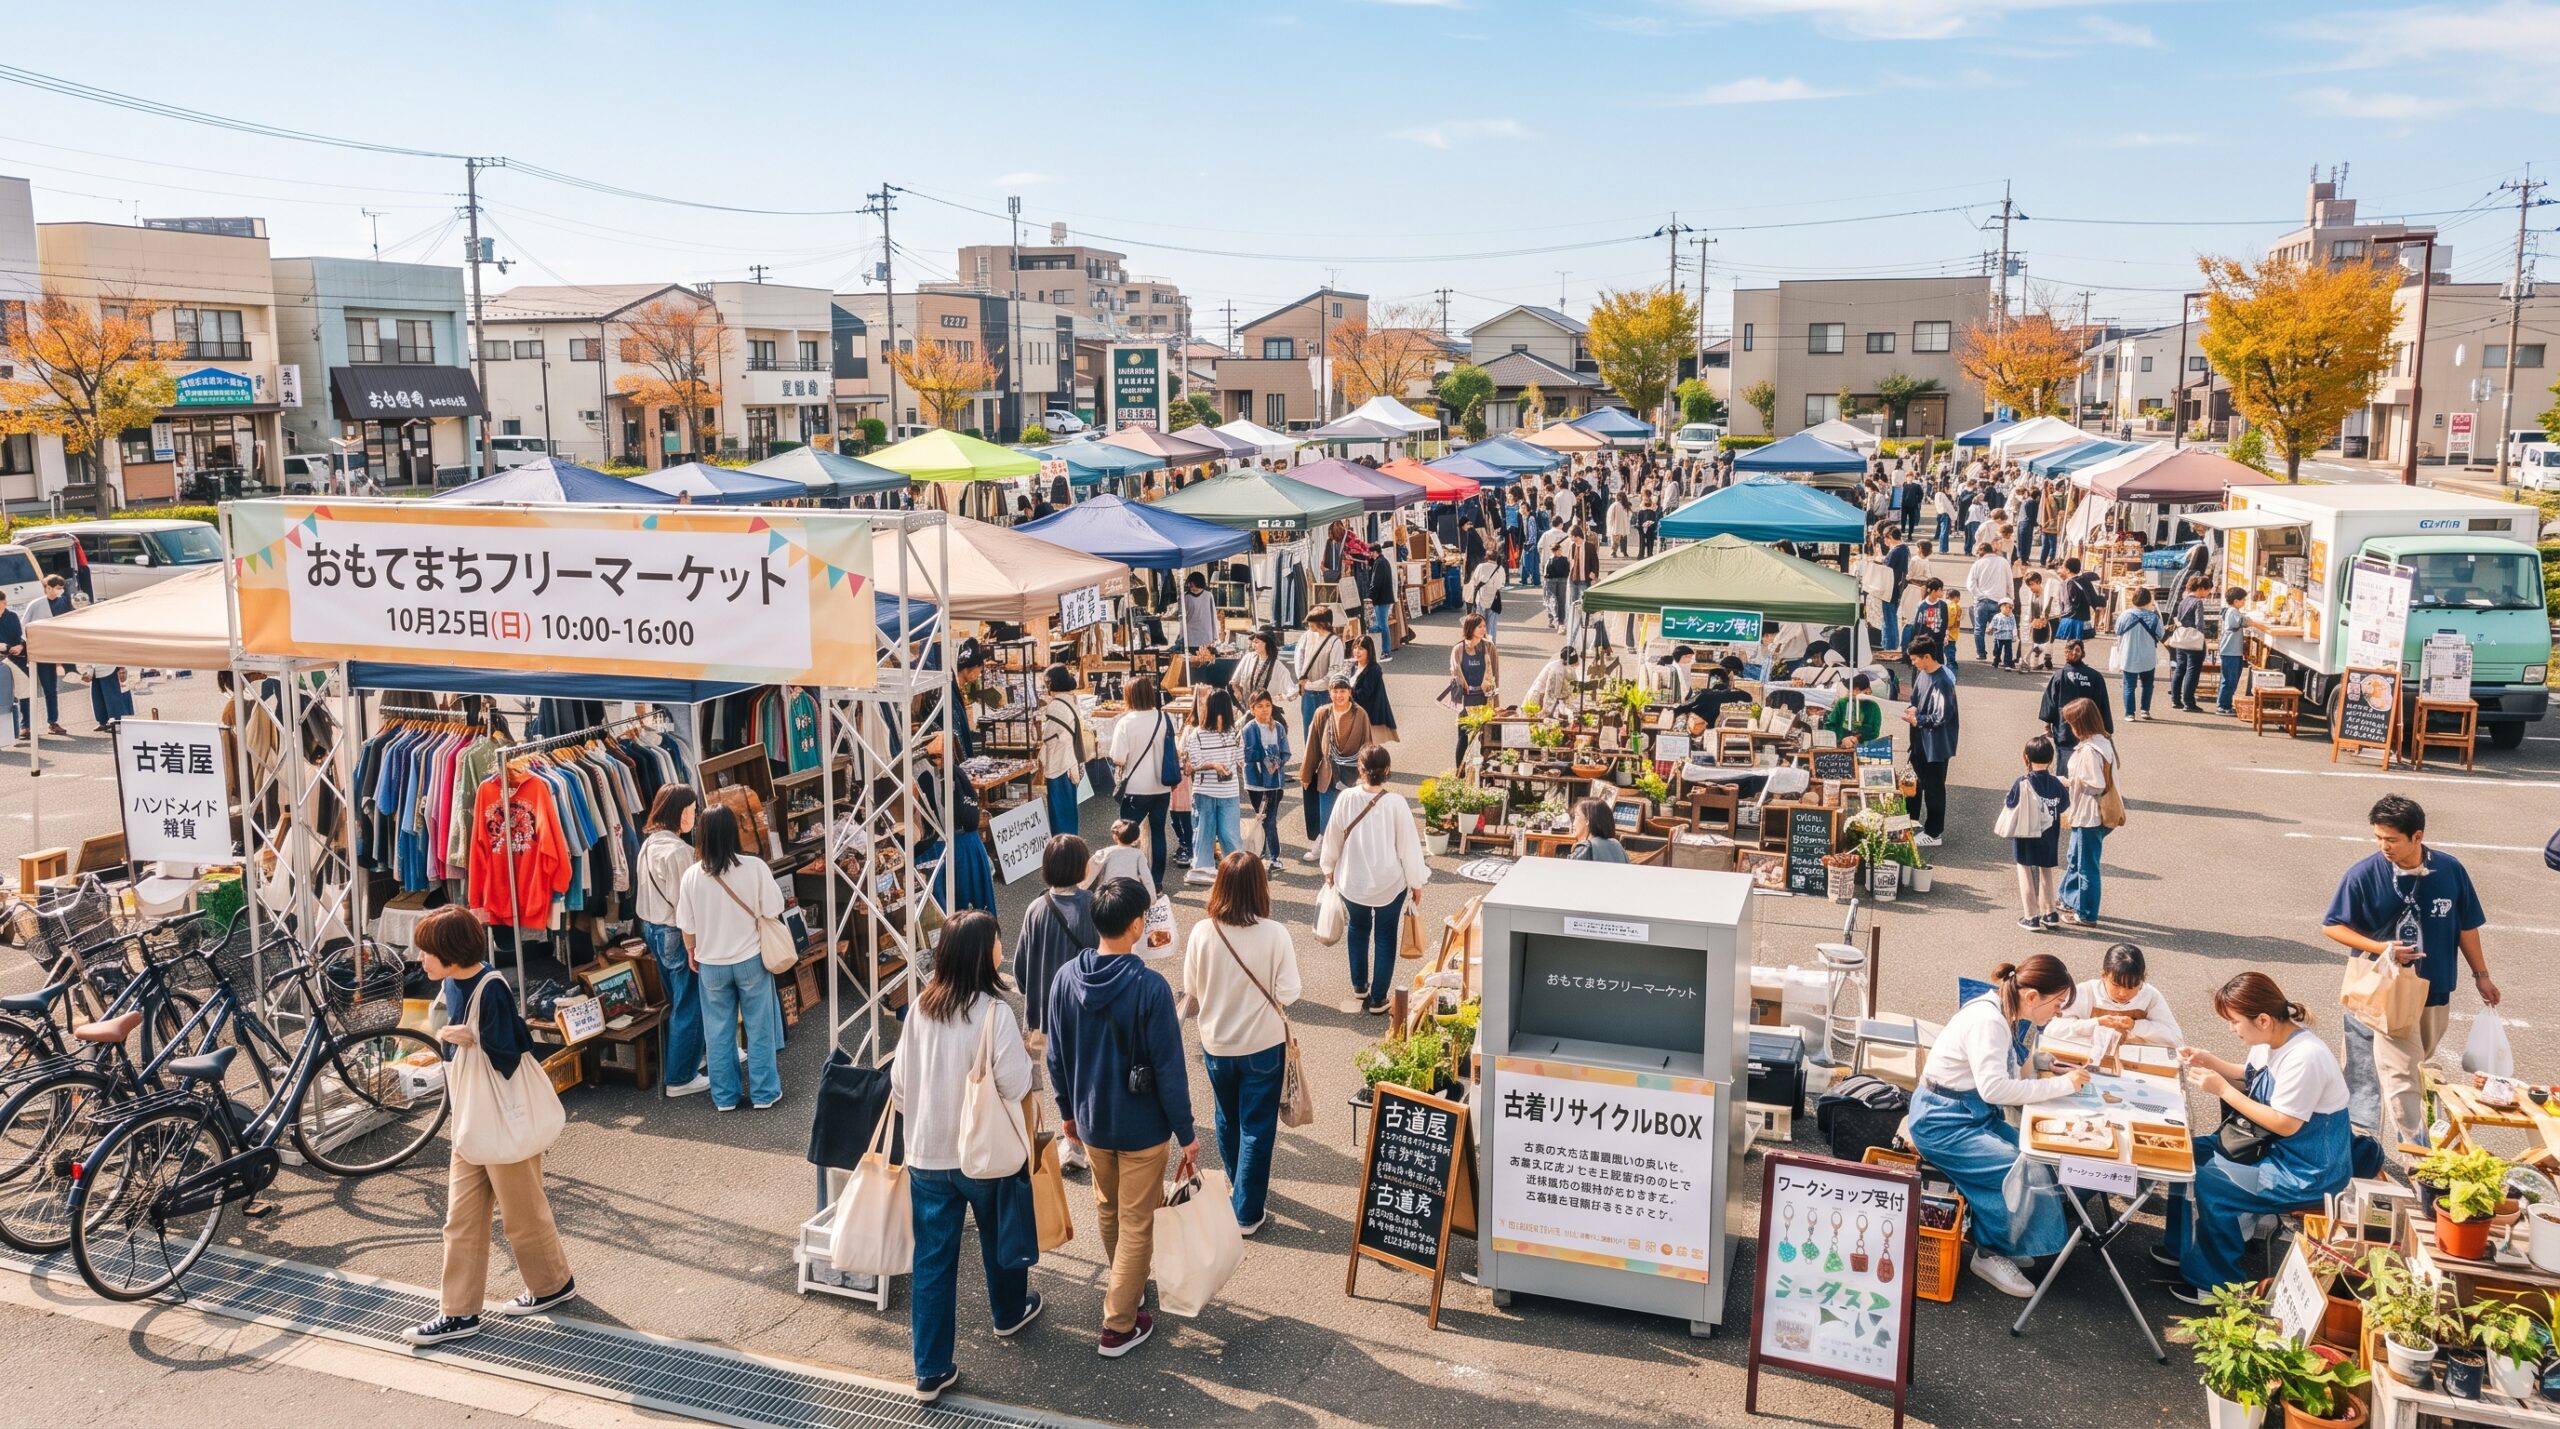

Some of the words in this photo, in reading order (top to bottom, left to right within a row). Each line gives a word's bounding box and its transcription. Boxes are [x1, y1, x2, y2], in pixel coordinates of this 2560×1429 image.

[306, 541, 787, 605] おもてまちフリーマーケット
[386, 606, 531, 643] 10月25日(日)
[541, 614, 695, 647] 10:00-16:00
[132, 741, 215, 775] 古着屋
[134, 797, 218, 818] ハンドメイド
[163, 818, 197, 840] 雑貨
[1384, 1101, 1449, 1142] 古道屋
[1504, 1089, 1703, 1140] 古着リサイクルBOX
[1777, 1176, 1905, 1212] ワークショップ受付
